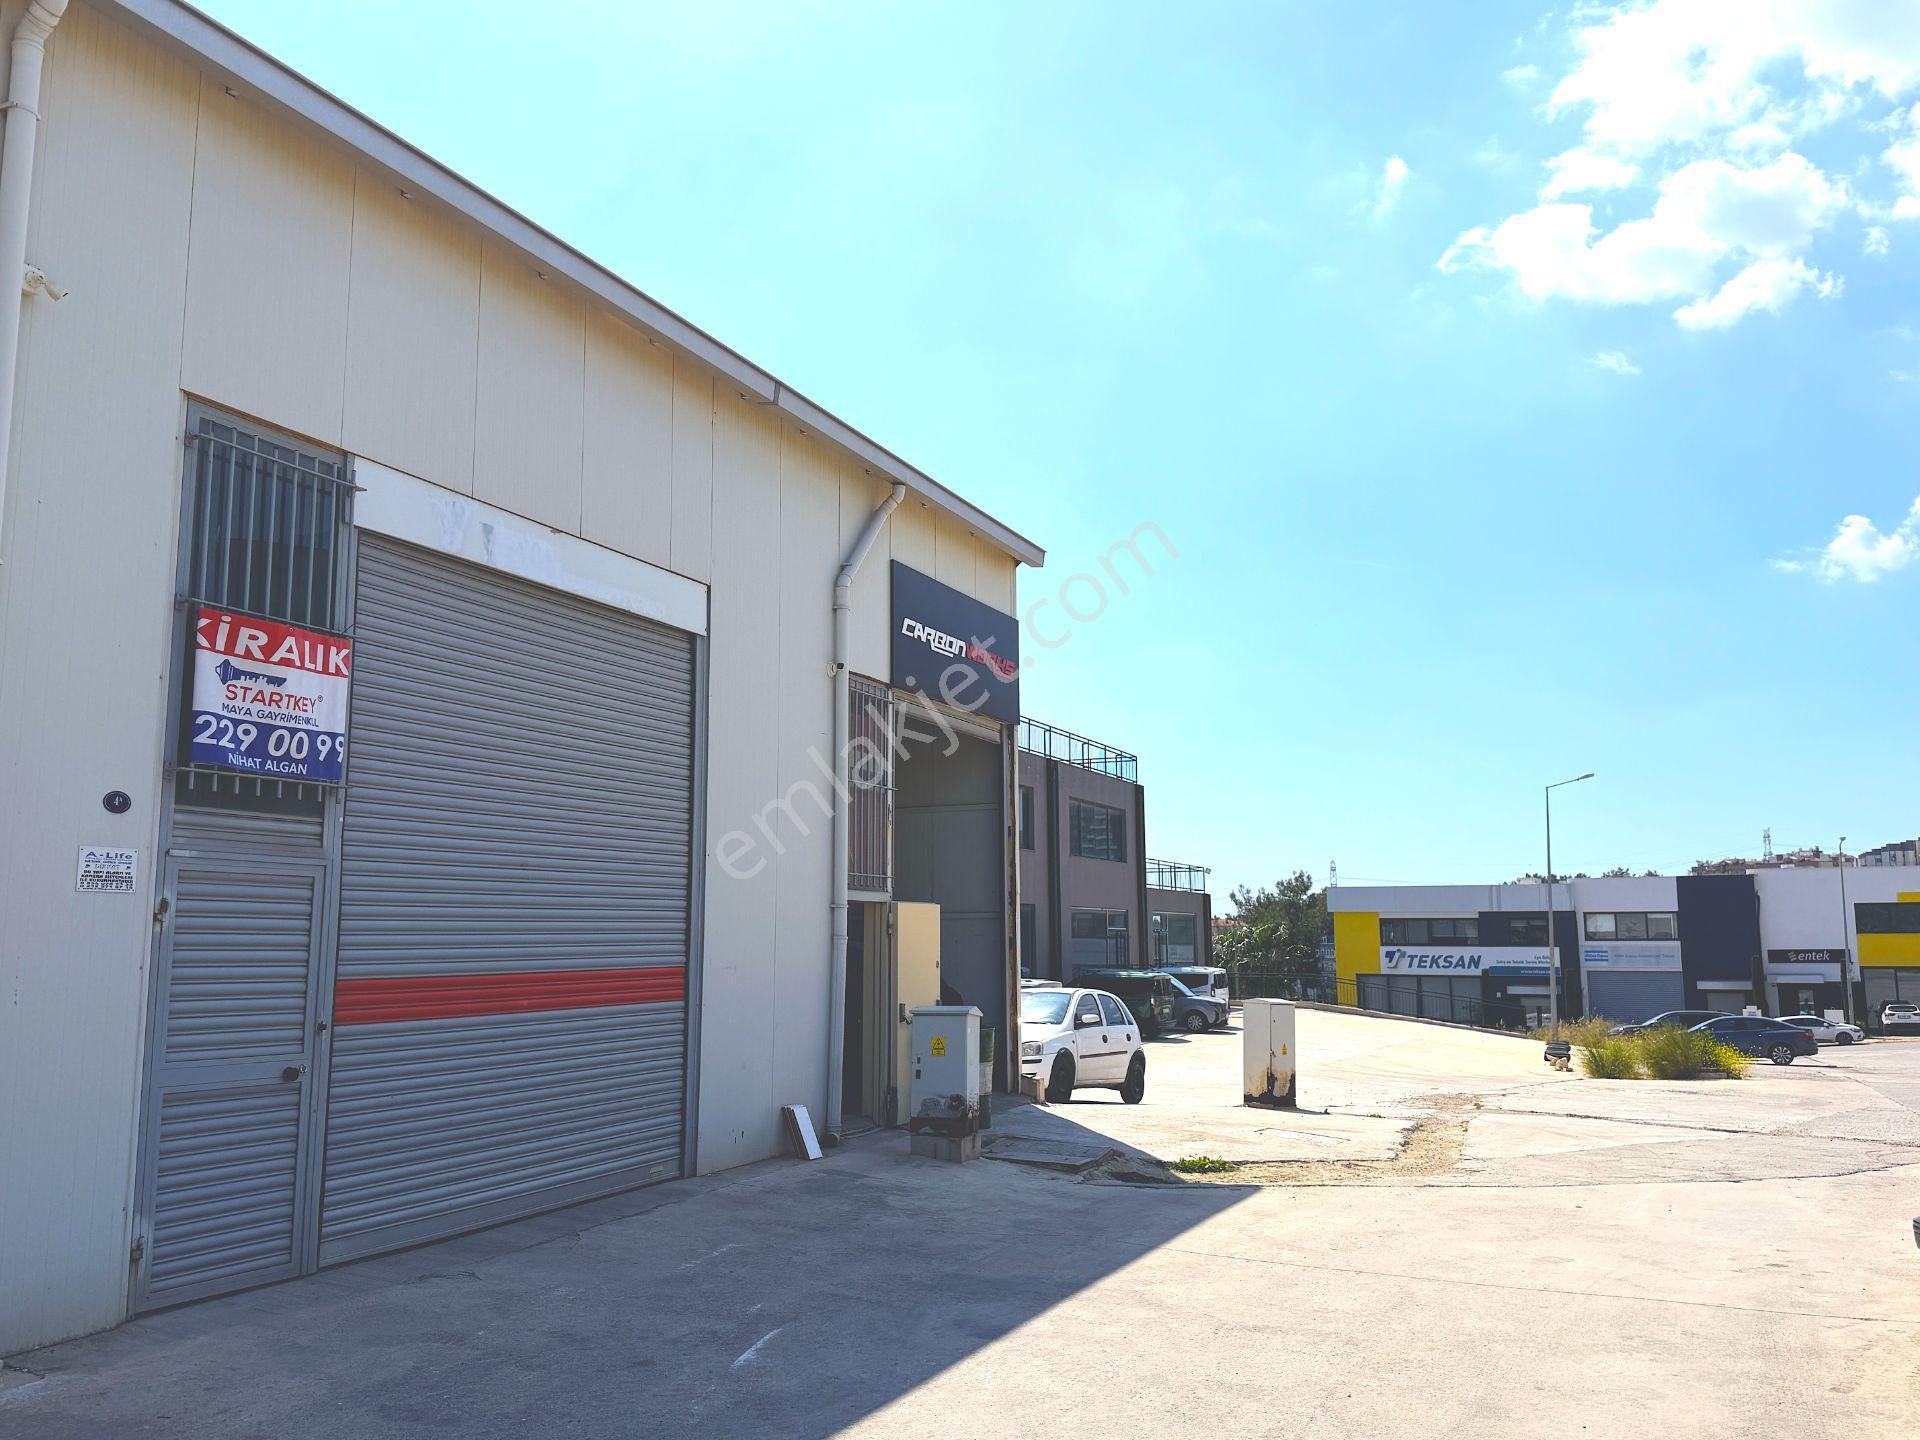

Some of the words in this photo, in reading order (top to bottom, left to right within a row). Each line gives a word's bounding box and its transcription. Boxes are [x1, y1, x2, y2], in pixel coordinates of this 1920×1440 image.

[196, 615, 350, 676] KİRALIK
[221, 703, 253, 717] MAYA
[193, 715, 258, 751] 229
[267, 728, 310, 760] 00
[228, 751, 262, 770] NİHAT
[264, 759, 308, 775] ALGAN
[1406, 954, 1482, 969] TEKSAN
[1797, 950, 1830, 961] entek
